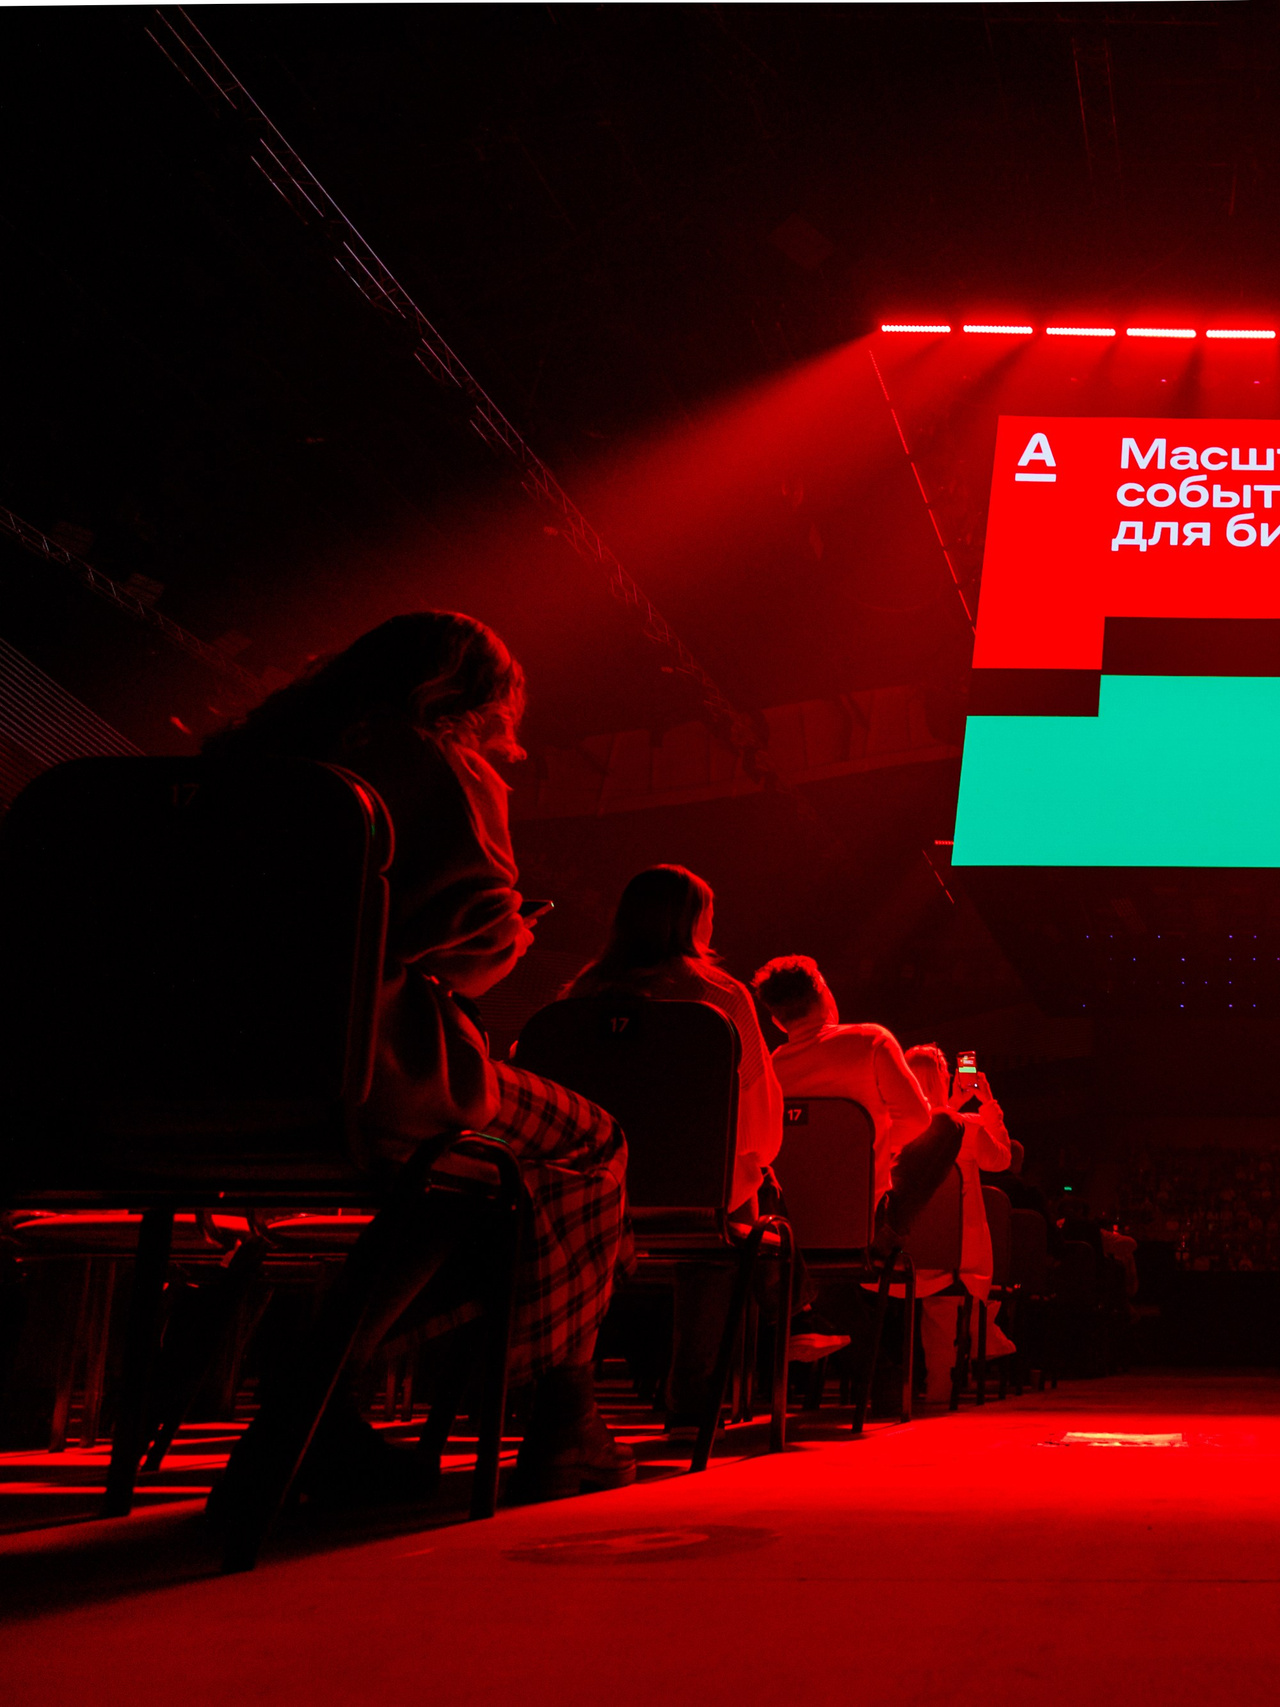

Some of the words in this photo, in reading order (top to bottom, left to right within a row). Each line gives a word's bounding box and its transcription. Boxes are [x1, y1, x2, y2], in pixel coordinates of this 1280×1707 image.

[1111, 520, 1211, 552] для
[168, 782, 200, 807] 17
[609, 1015, 630, 1032] 17
[788, 1109, 802, 1121] 17
